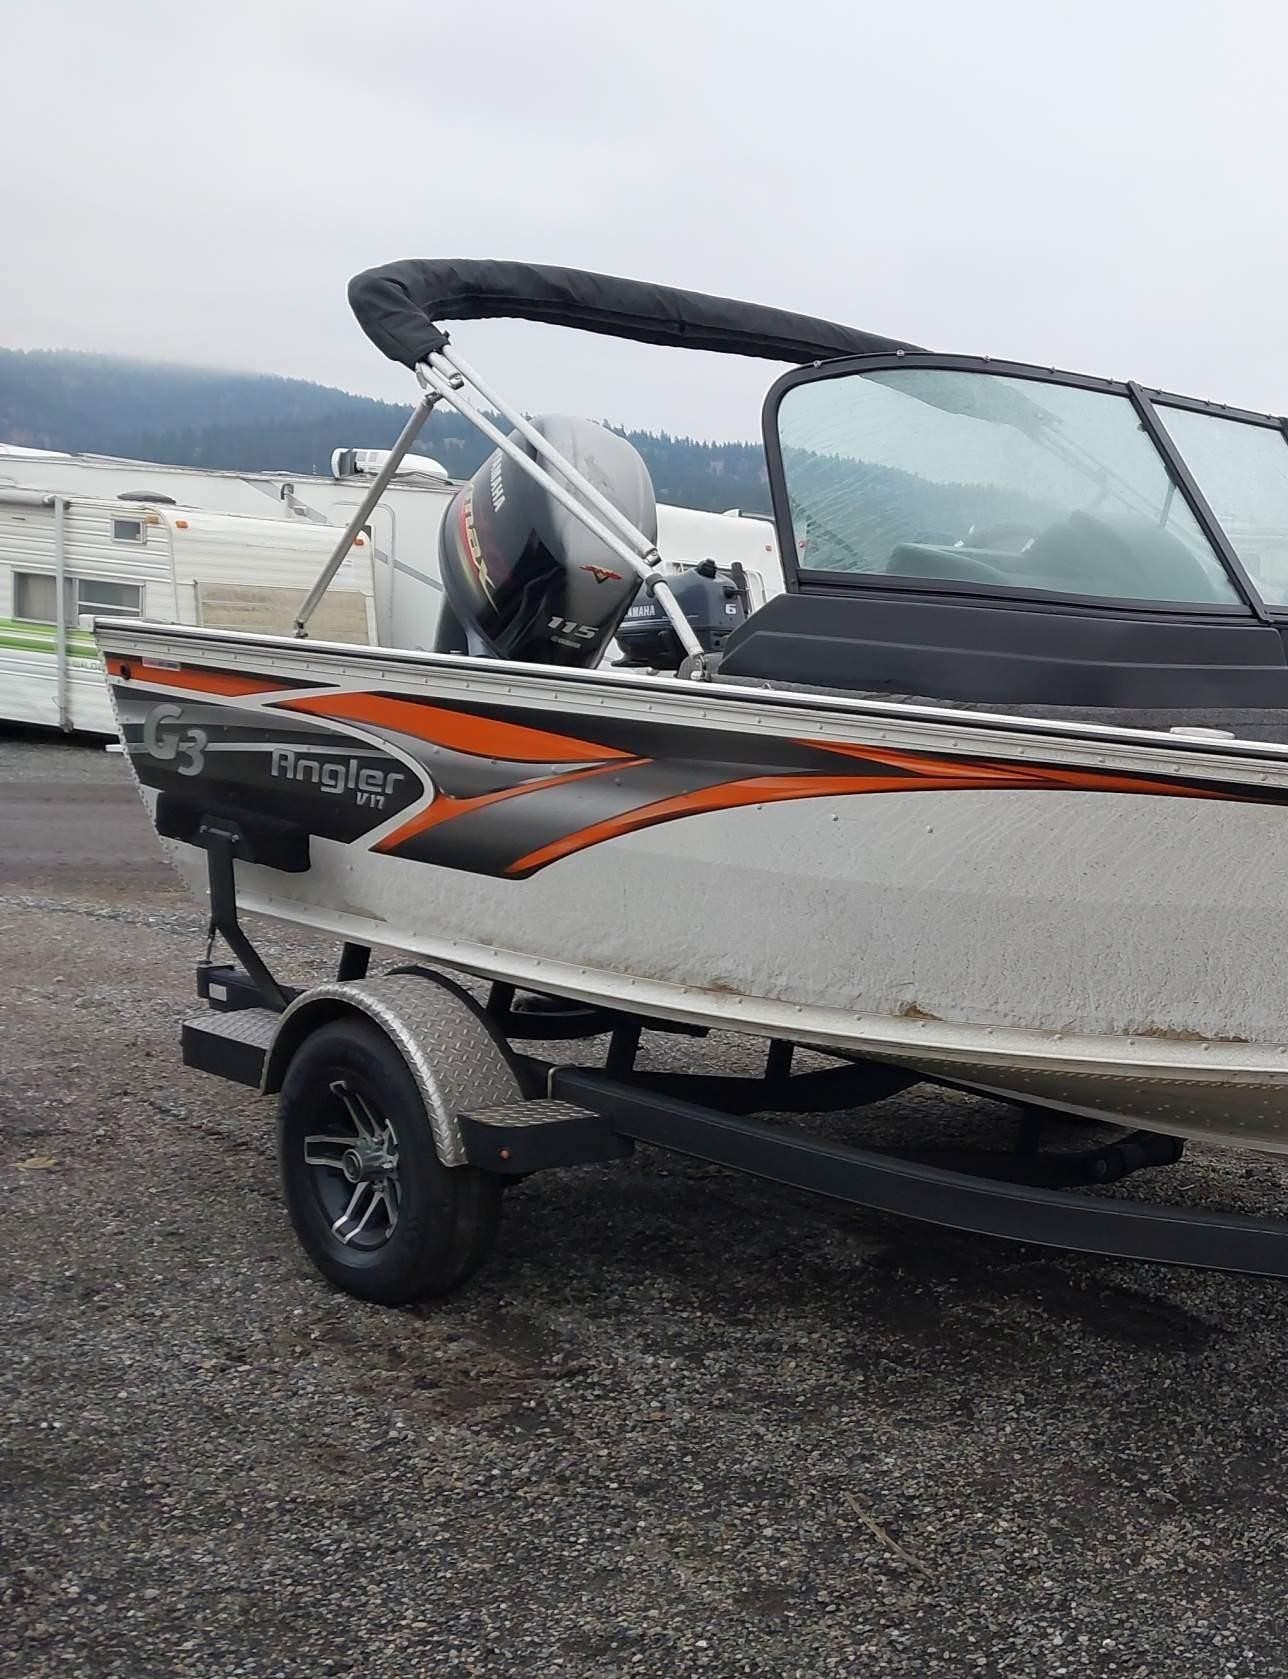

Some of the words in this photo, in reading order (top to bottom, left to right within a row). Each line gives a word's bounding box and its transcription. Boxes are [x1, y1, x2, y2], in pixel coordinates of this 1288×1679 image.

[725, 603, 737, 615] 6
[547, 616, 599, 639] 115
[144, 703, 208, 777] G3
[271, 748, 405, 794] Angler
